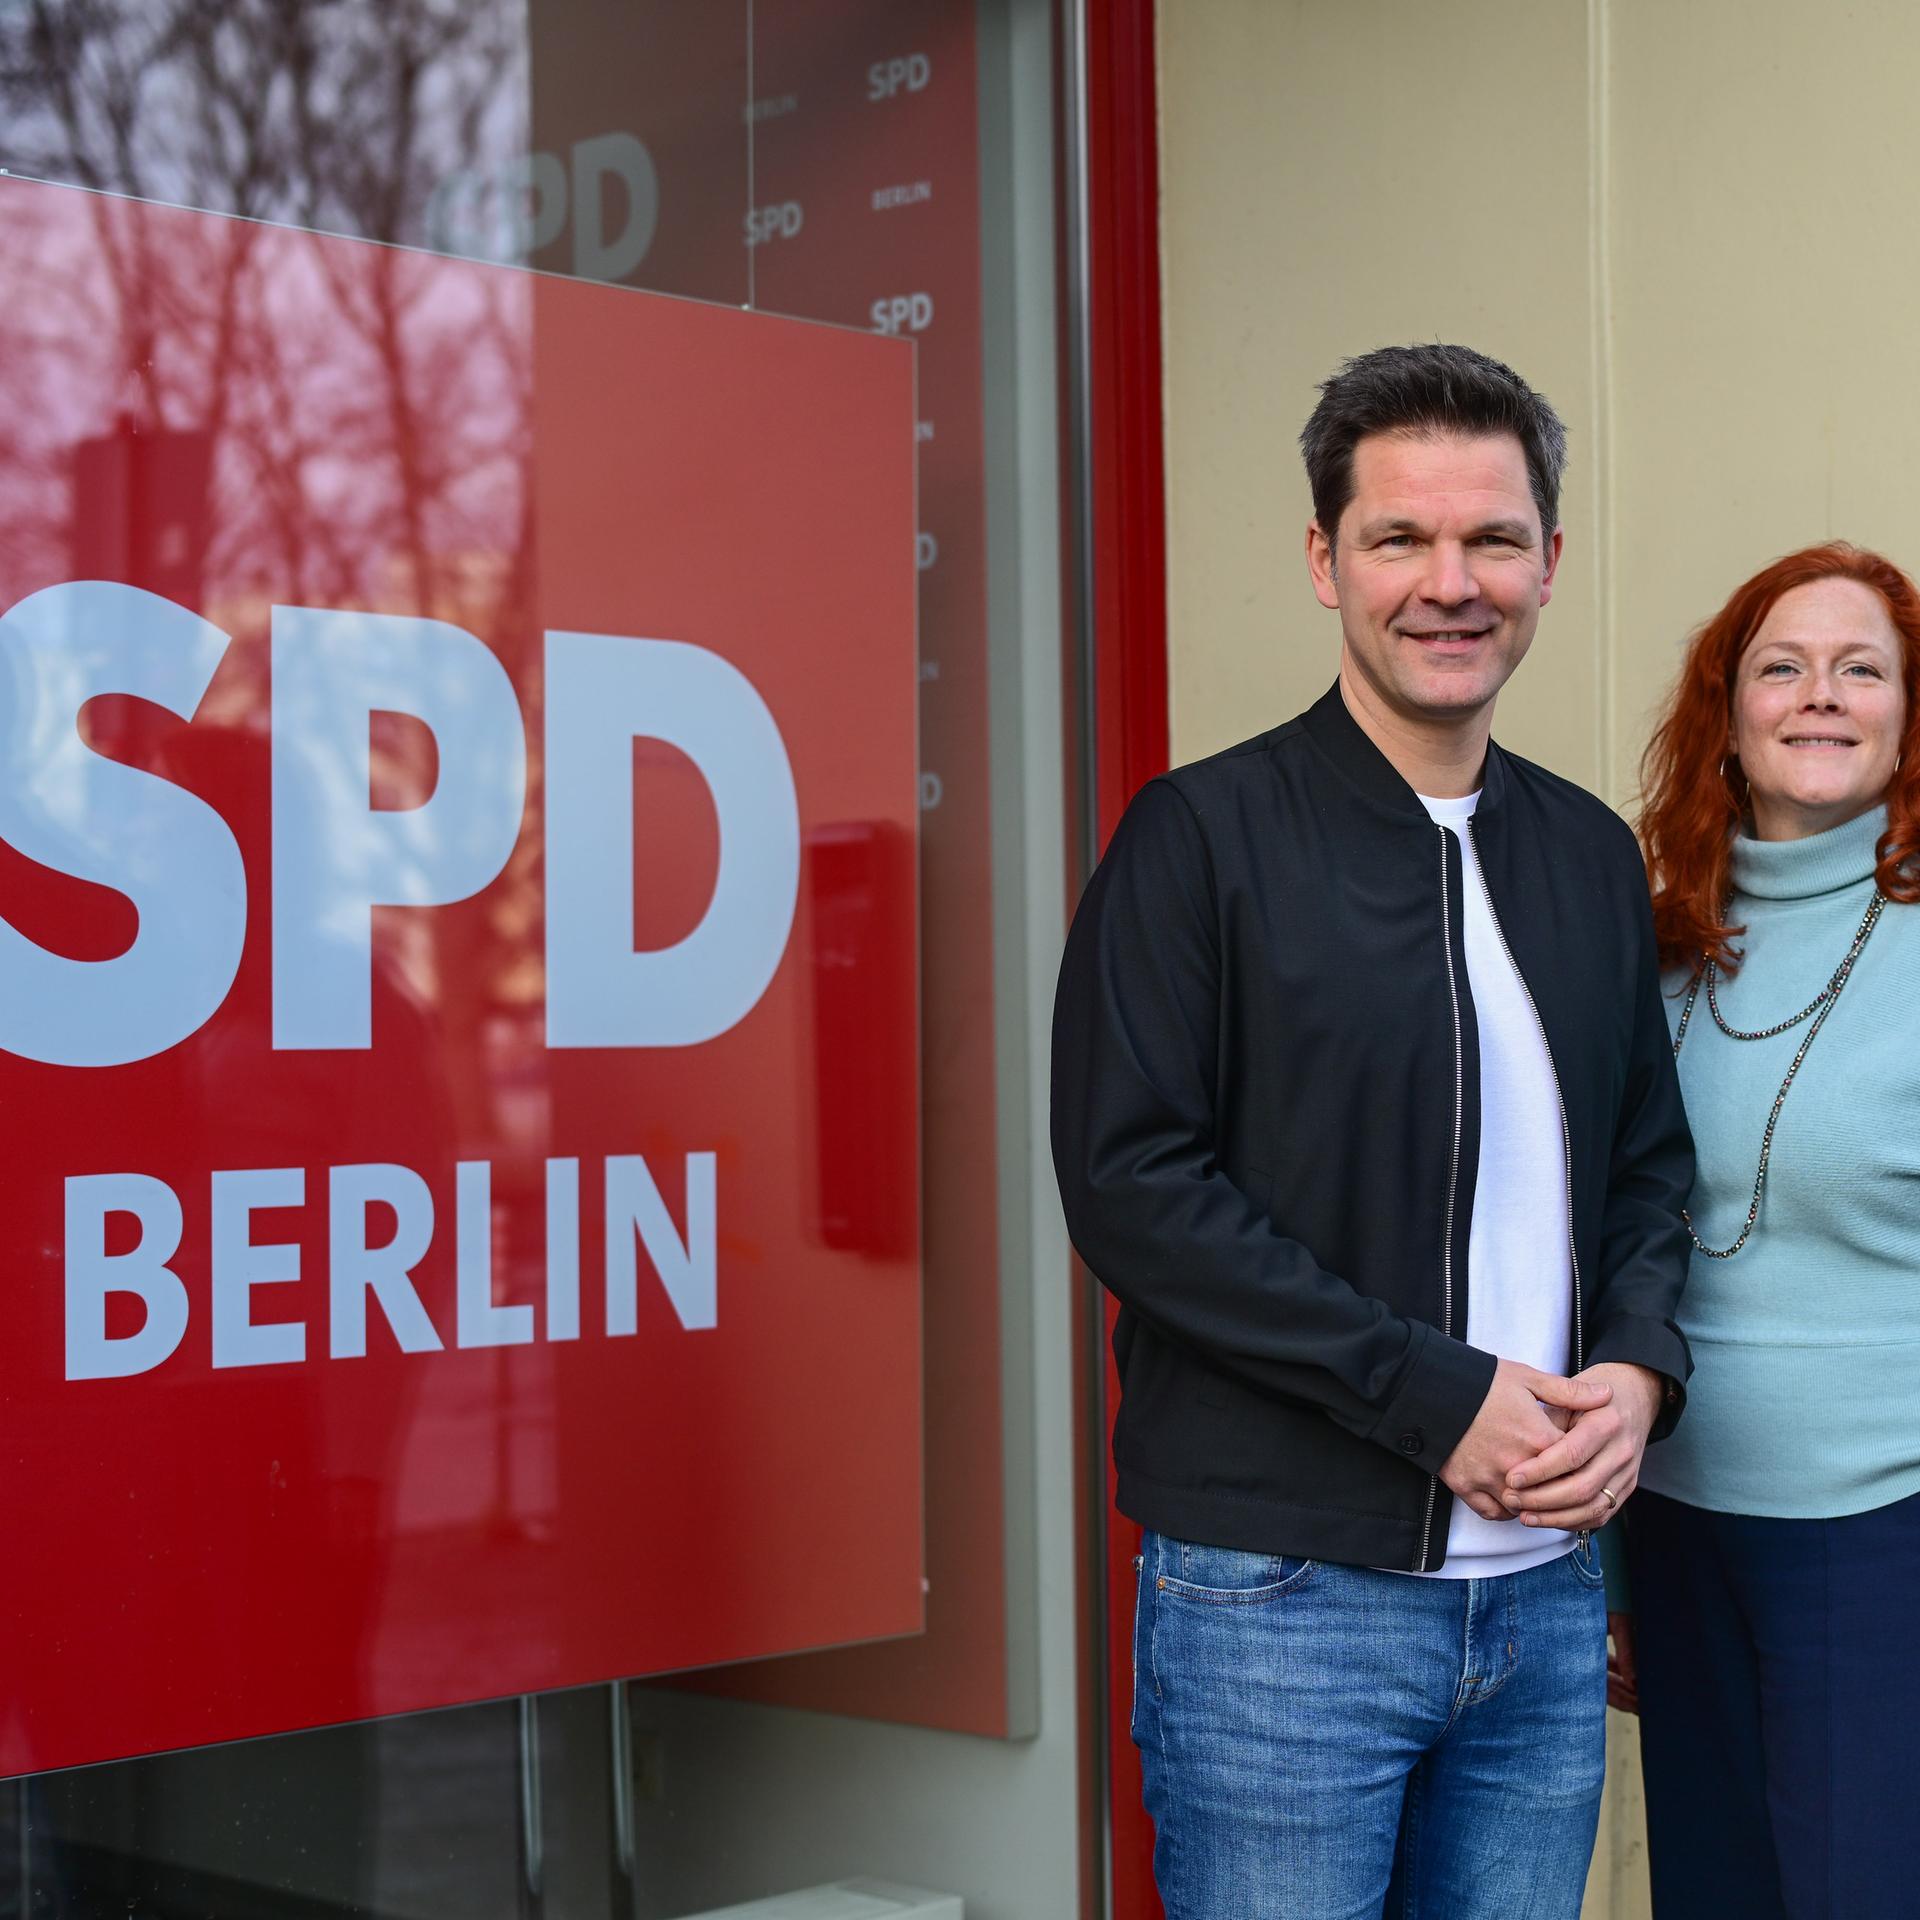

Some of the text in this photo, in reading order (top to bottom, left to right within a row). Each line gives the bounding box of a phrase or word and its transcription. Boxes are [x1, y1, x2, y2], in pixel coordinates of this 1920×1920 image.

[868, 54, 930, 101] SPD
[872, 181, 931, 210] BERLIN
[745, 202, 803, 246] SPD
[870, 293, 933, 335] SPD
[0, 580, 800, 1067] SPD
[65, 1151, 717, 1381] BERLIN
